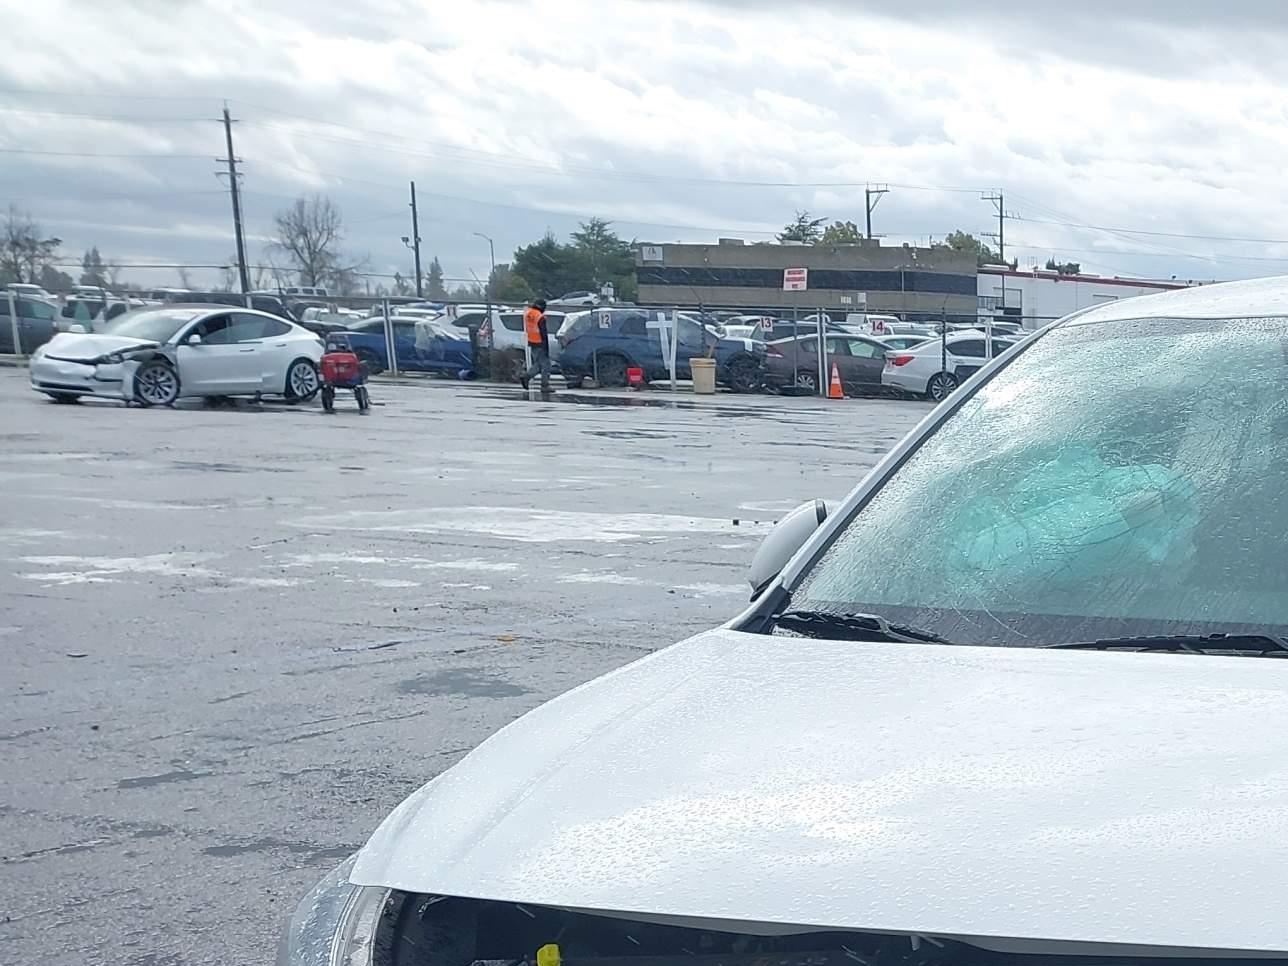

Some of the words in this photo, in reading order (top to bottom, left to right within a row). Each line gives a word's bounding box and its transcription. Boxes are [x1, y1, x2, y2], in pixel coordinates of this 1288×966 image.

[600, 314, 610, 325] 12
[760, 318, 772, 328] 13
[872, 321, 884, 332] 14
